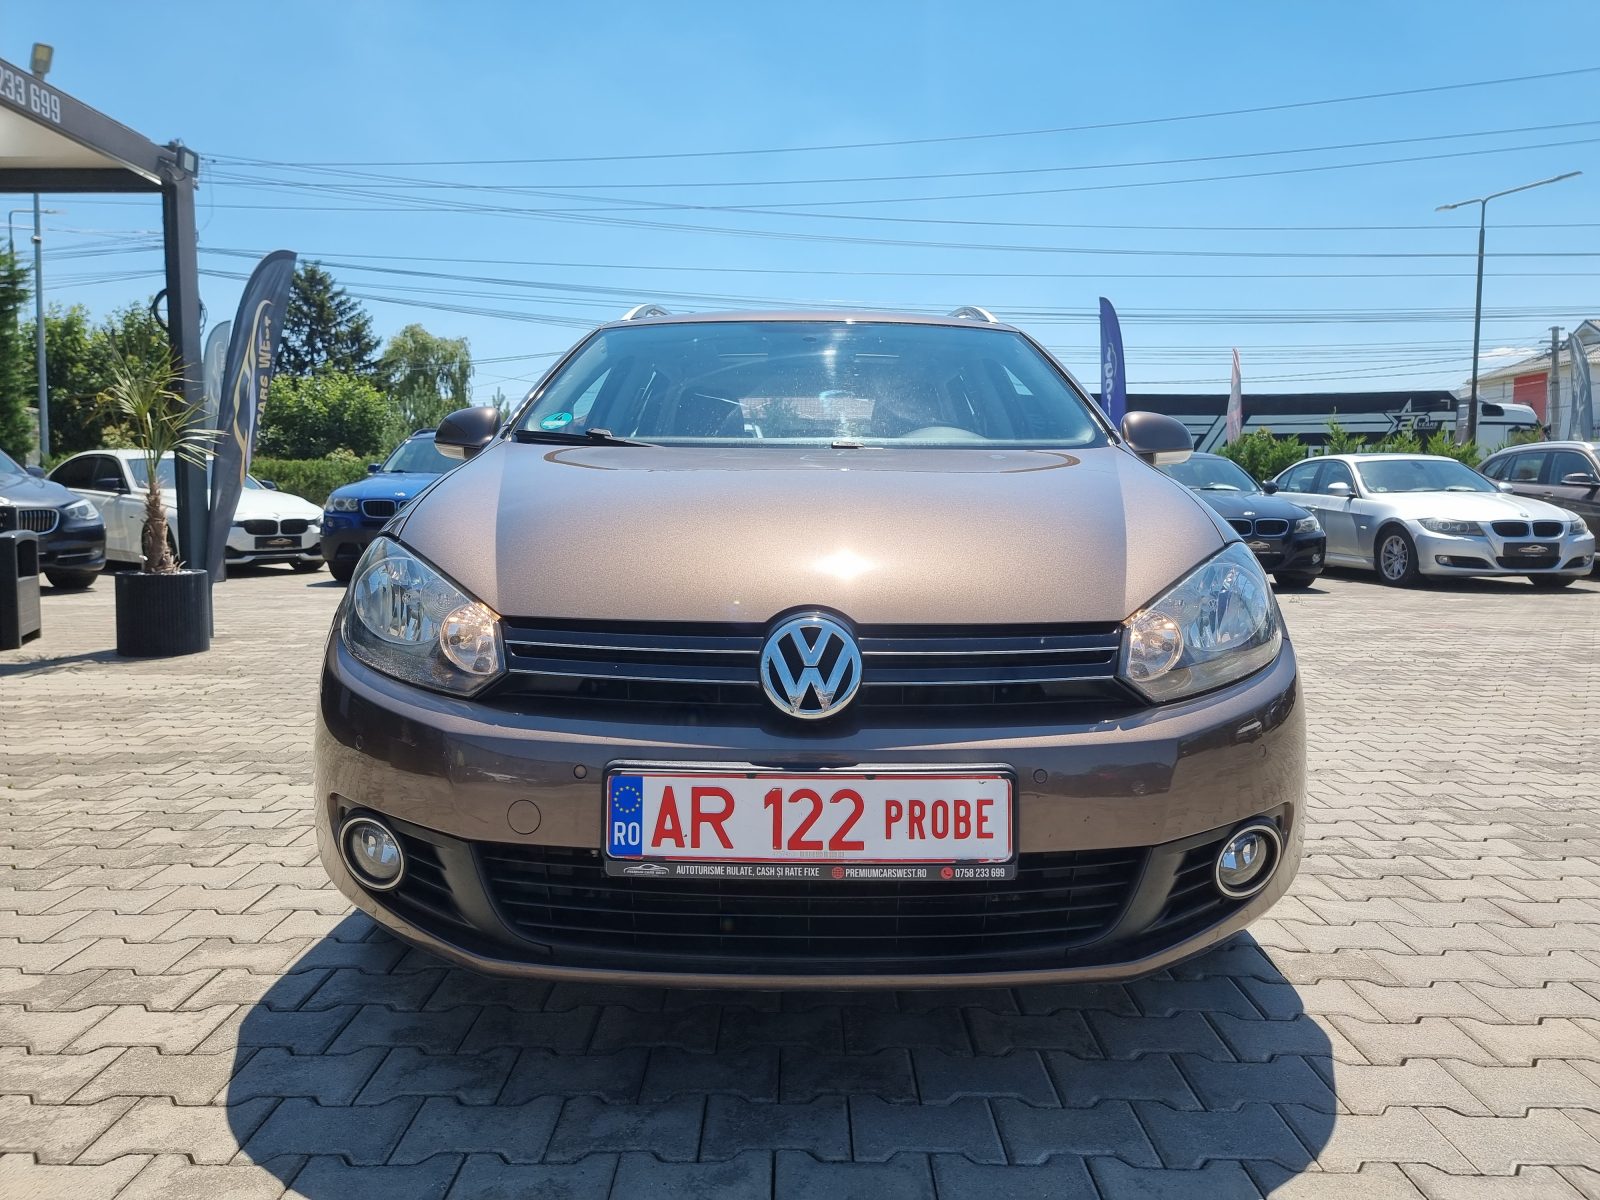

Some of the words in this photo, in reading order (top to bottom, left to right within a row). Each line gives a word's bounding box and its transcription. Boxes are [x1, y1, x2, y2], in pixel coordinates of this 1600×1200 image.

[30, 83, 61, 124] 699
[651, 785, 735, 850] AR
[763, 787, 865, 851] 122
[885, 799, 994, 840] PROBE
[613, 821, 640, 846] RO
[676, 865, 725, 875] AUTOTURISME
[726, 866, 755, 877] RULATE,
[756, 867, 775, 876] CASH
[785, 867, 803, 877] RATE
[804, 867, 820, 877] FIXE
[845, 868, 927, 878] PREMIUMCARSWEST.RO
[955, 868, 974, 878] 0758
[975, 868, 990, 878] 233
[991, 868, 1005, 878] 699
